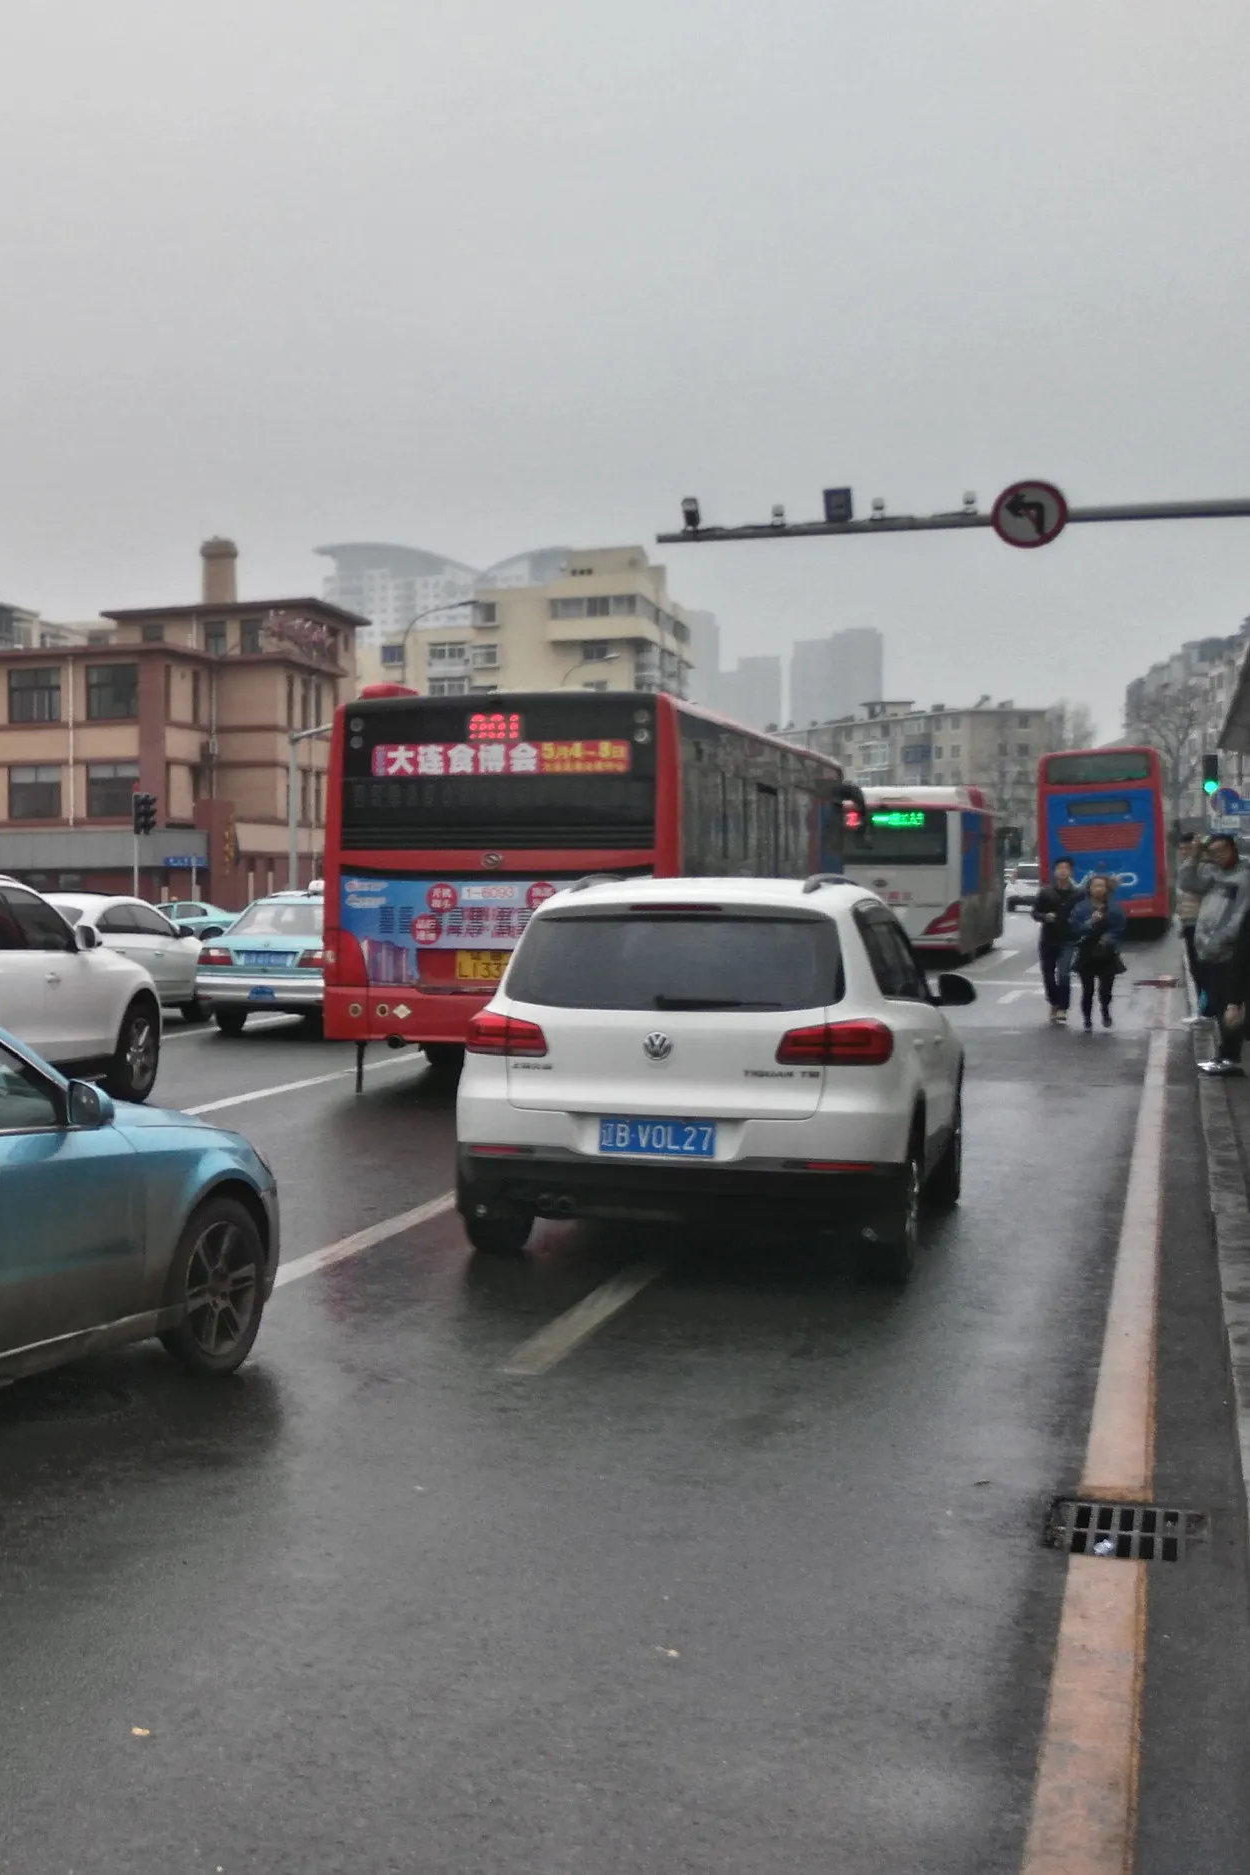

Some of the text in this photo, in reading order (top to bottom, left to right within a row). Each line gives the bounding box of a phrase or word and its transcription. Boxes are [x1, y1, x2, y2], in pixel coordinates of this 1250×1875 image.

[387, 743, 538, 774] 大连食博会
